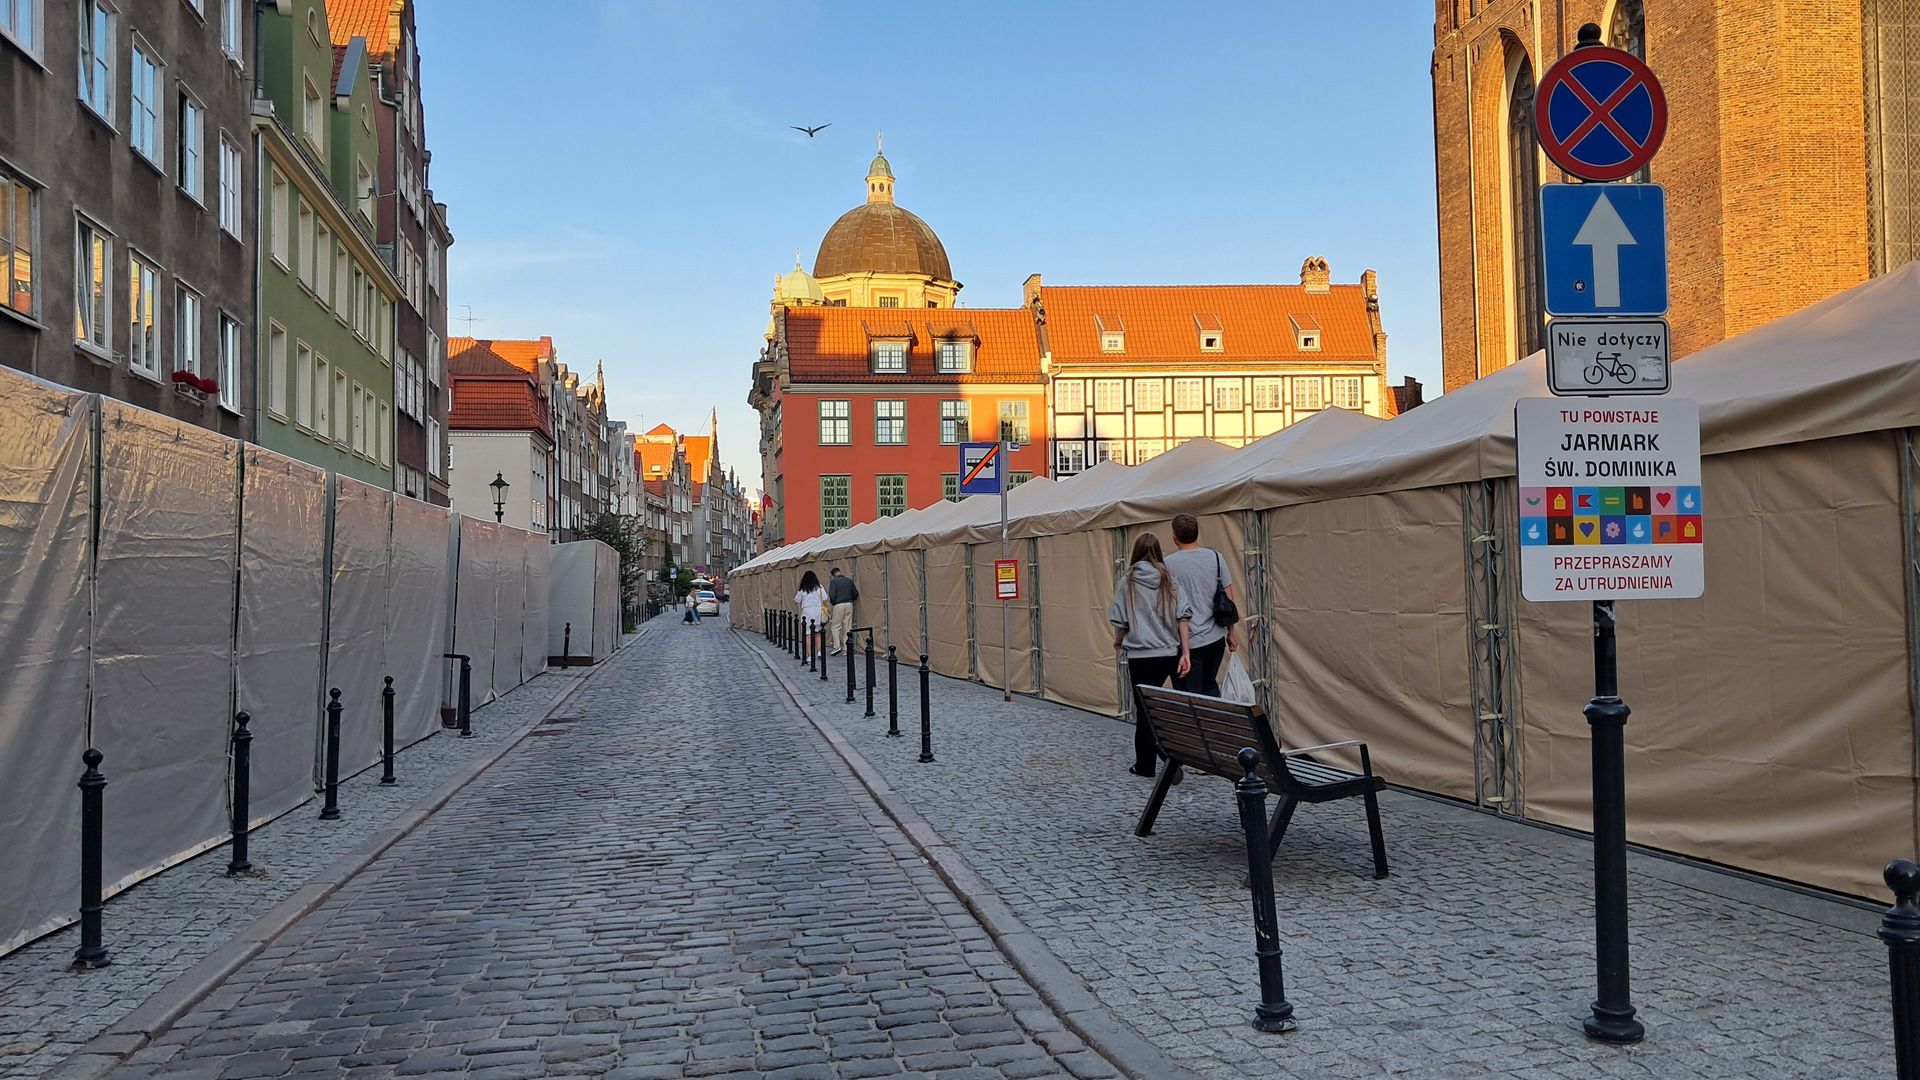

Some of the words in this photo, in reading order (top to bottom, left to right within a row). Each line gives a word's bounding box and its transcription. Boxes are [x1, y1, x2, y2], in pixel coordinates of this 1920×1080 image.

[1557, 332, 1587, 347] Nie
[1597, 331, 1662, 350] dotyczy
[1560, 410, 1579, 424] TU
[1583, 410, 1659, 424] POWSTAJE
[1560, 433, 1661, 452] JARMARK
[1544, 456, 1580, 478] ŚW.
[1584, 459, 1677, 478] DOMINIKA
[1554, 554, 1674, 571] PRZEPRASZAMY
[1554, 577, 1574, 591] ZA
[1577, 574, 1673, 591] UTRUDNIENIA
